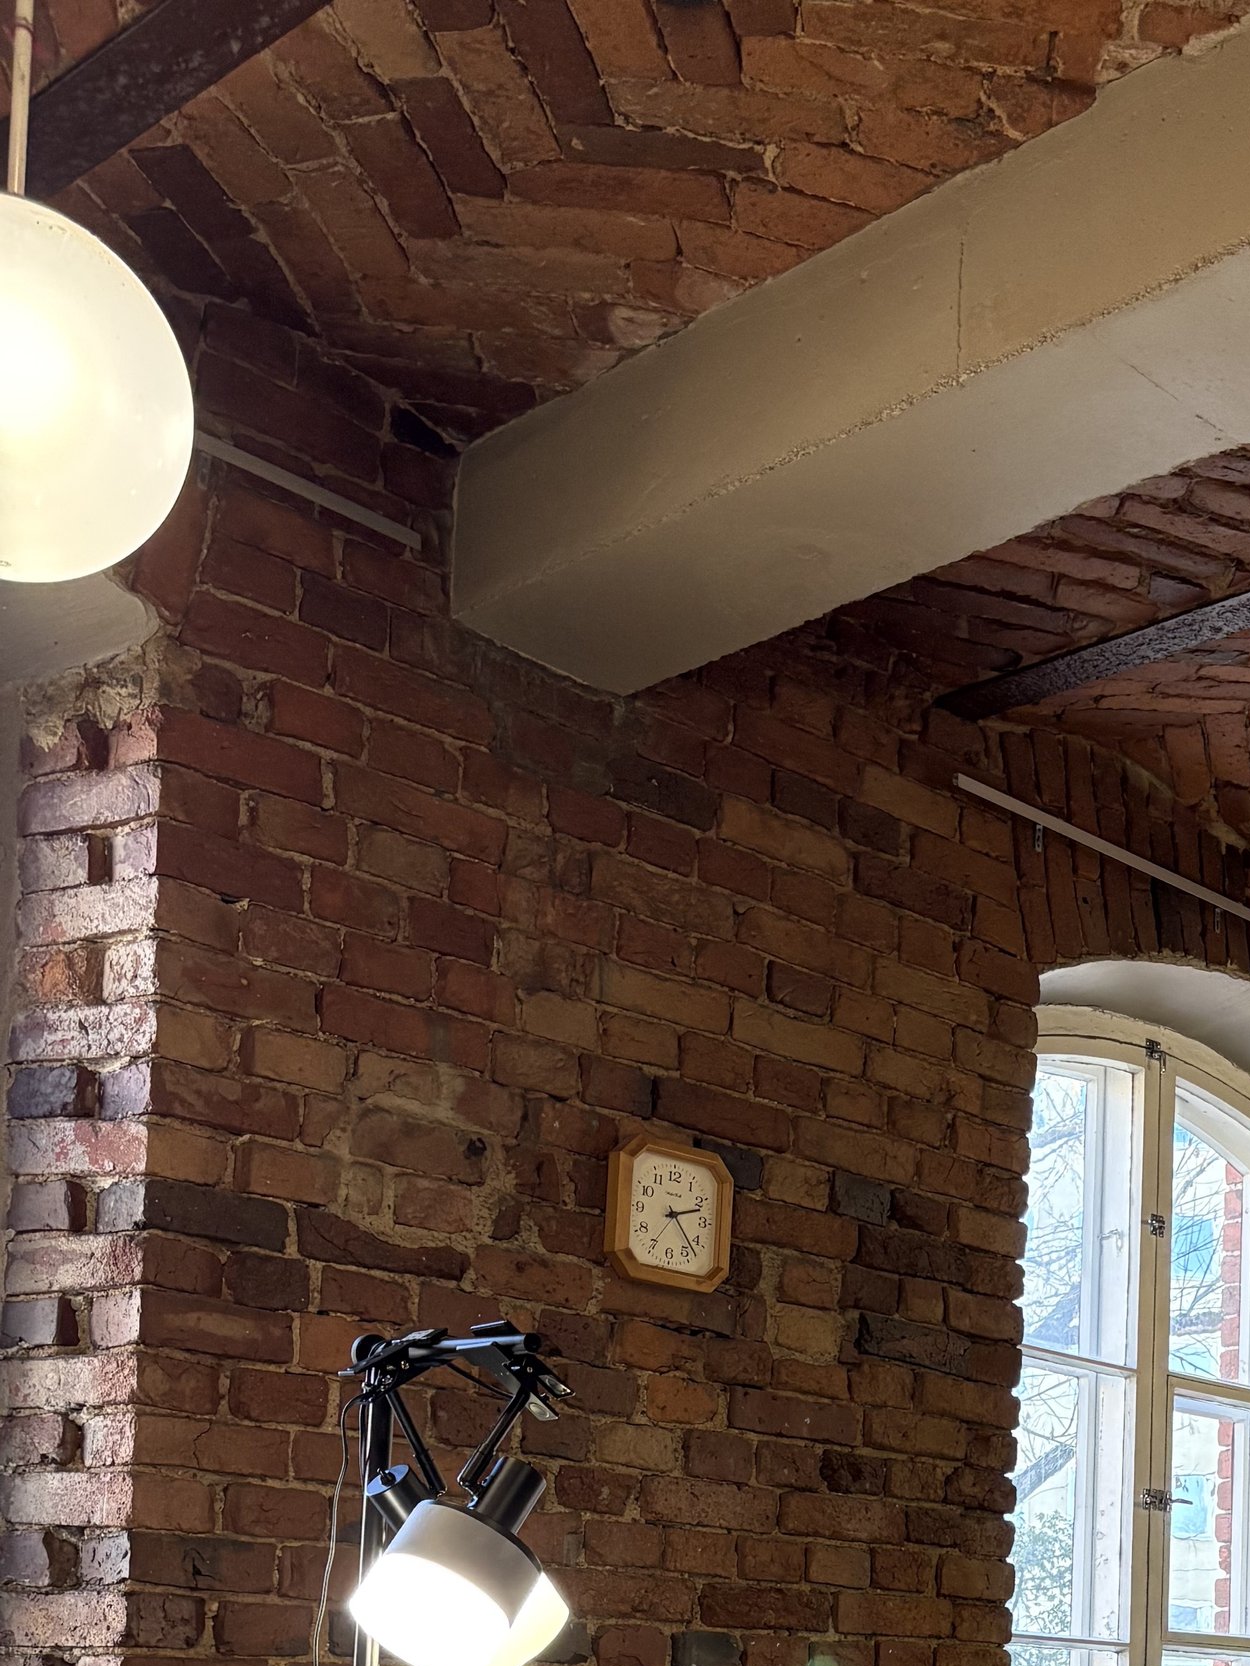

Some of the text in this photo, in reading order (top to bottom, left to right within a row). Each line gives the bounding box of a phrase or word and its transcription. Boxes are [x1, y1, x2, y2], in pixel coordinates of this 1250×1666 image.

[654, 1173, 663, 1185] 11
[668, 1170, 682, 1184] 12
[642, 1185, 655, 1198] 10
[635, 1200, 645, 1213] 9
[694, 1195, 704, 1209] 2
[638, 1220, 648, 1234] 8
[698, 1216, 707, 1228] 3
[648, 1238, 658, 1250] 7
[692, 1234, 700, 1246] 4
[665, 1247, 674, 1259] 6
[680, 1245, 689, 1258] 5
